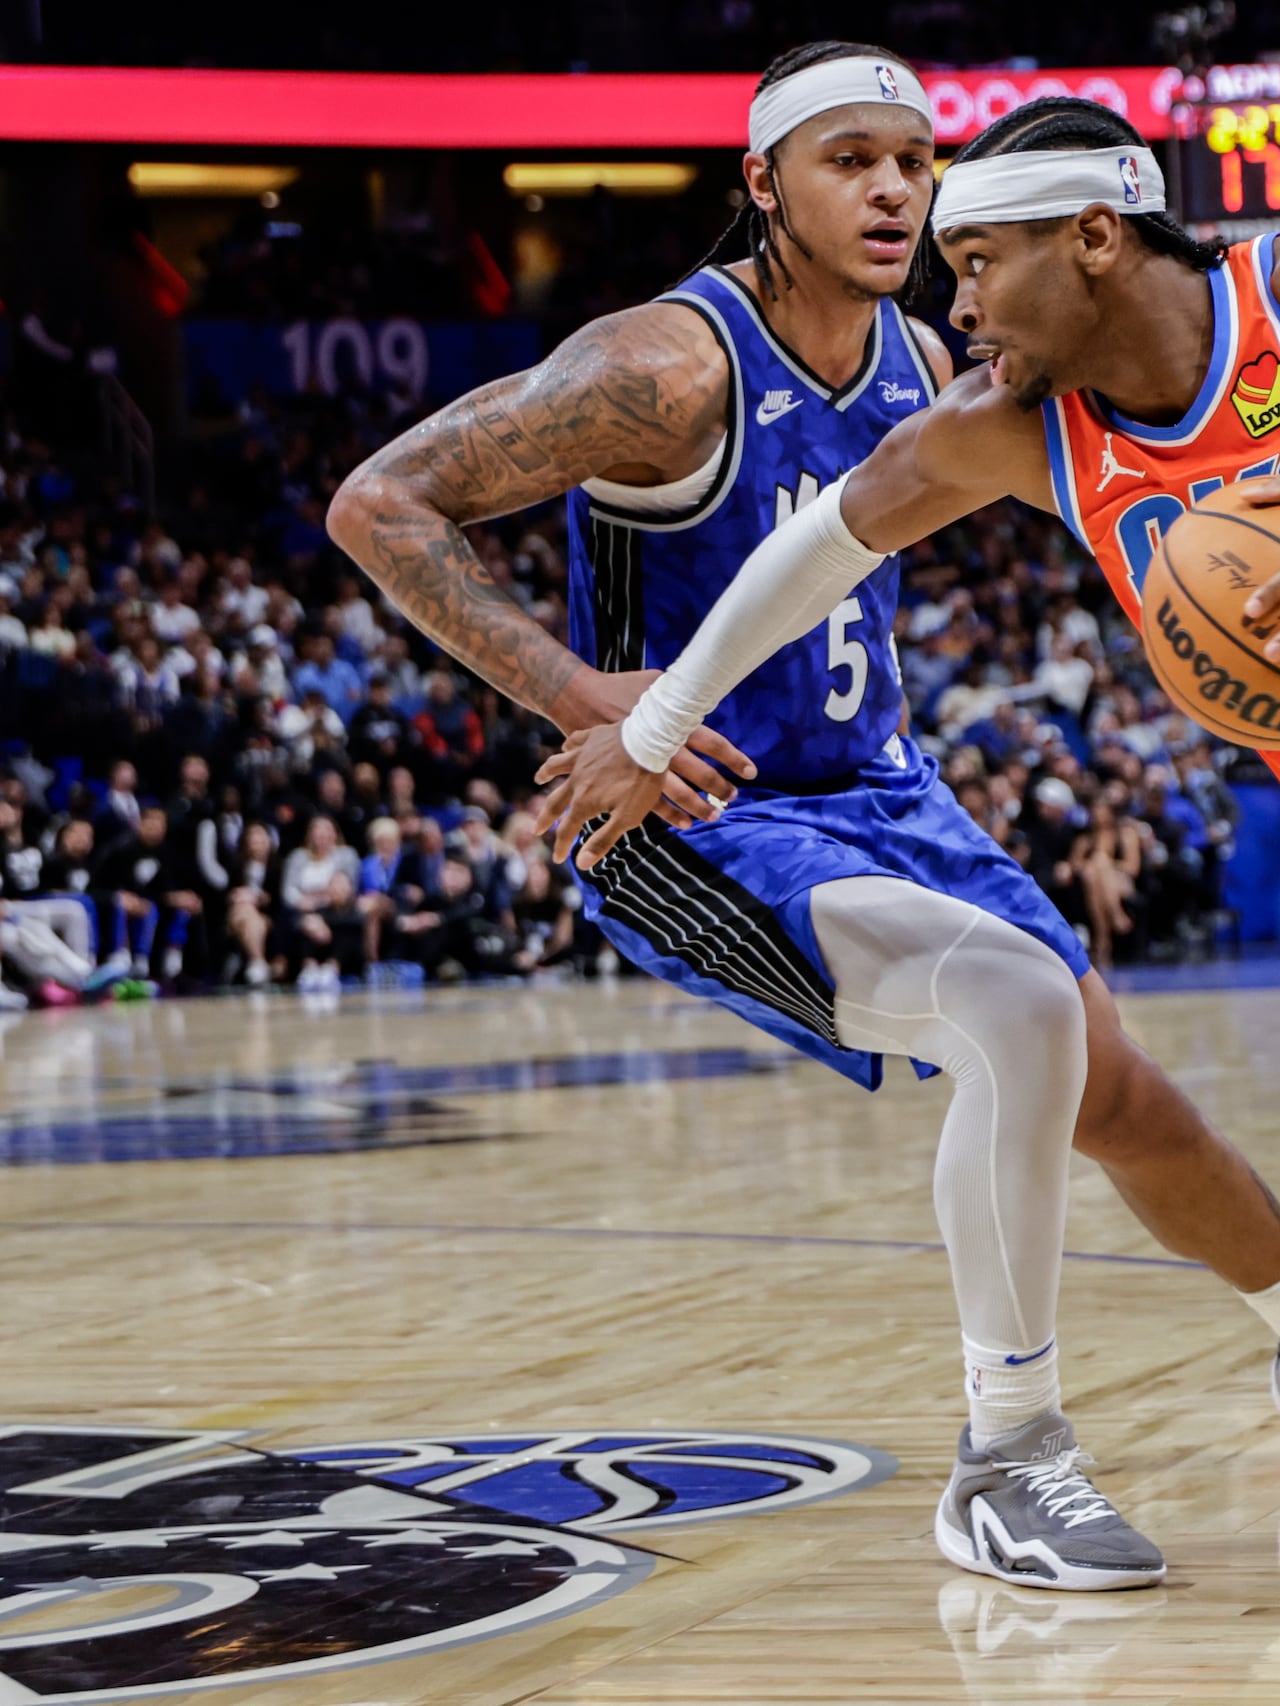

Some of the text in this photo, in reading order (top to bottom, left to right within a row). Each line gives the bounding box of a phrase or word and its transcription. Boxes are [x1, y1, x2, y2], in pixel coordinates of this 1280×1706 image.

[283, 318, 429, 411] 109
[877, 381, 921, 406] Disney
[763, 390, 793, 411] NIKE
[824, 597, 869, 722] 5
